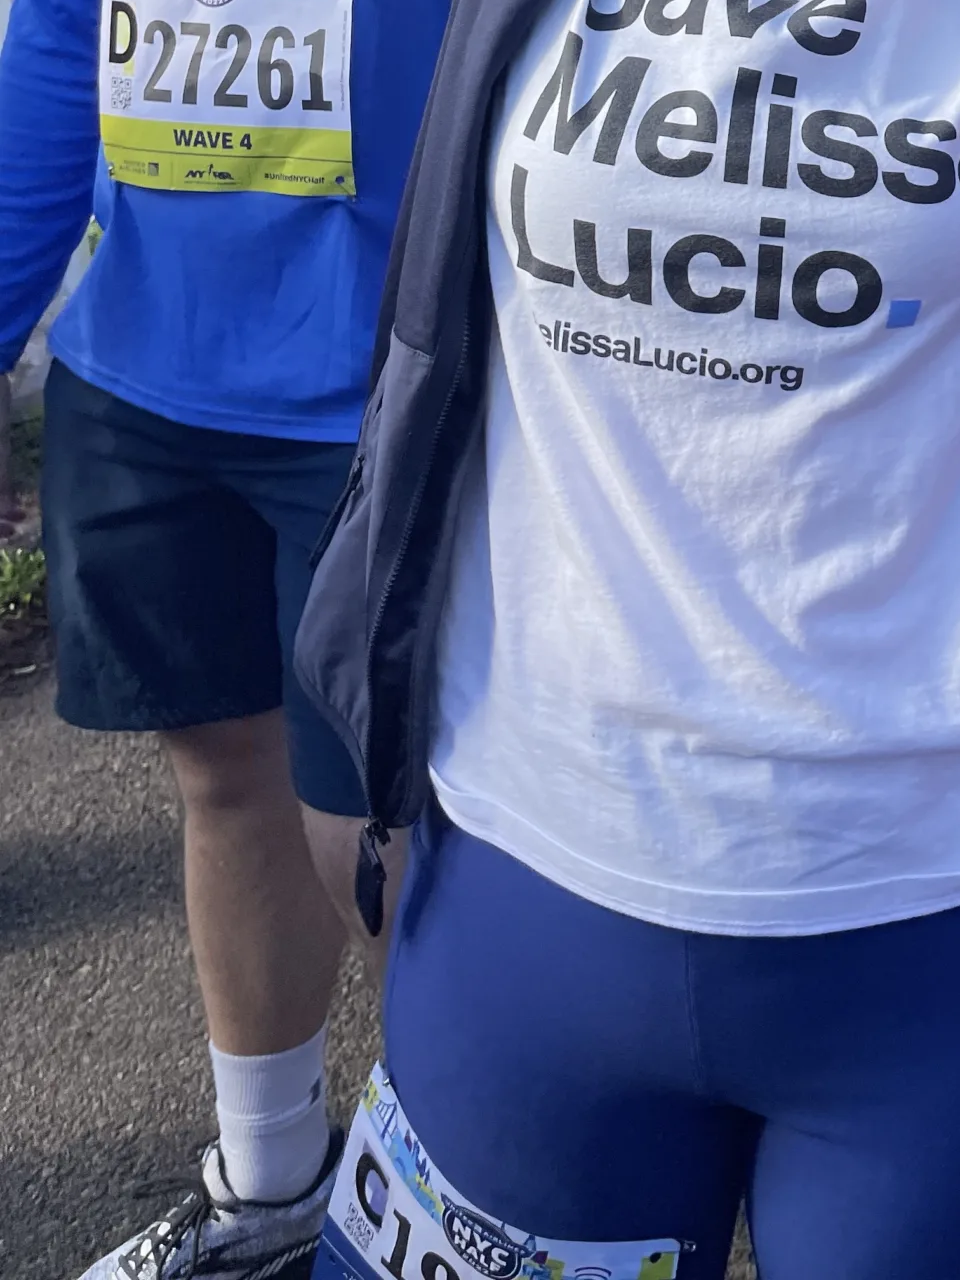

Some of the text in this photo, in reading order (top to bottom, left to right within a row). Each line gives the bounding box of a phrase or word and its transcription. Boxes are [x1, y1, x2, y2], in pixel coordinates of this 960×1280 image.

[173, 129, 252, 150] WAVE 4
[510, 162, 921, 328] Lucio.
[538, 320, 804, 391] elissaLucio.org
[453, 1216, 509, 1266] NYC
[454, 1234, 501, 1271] HALF
